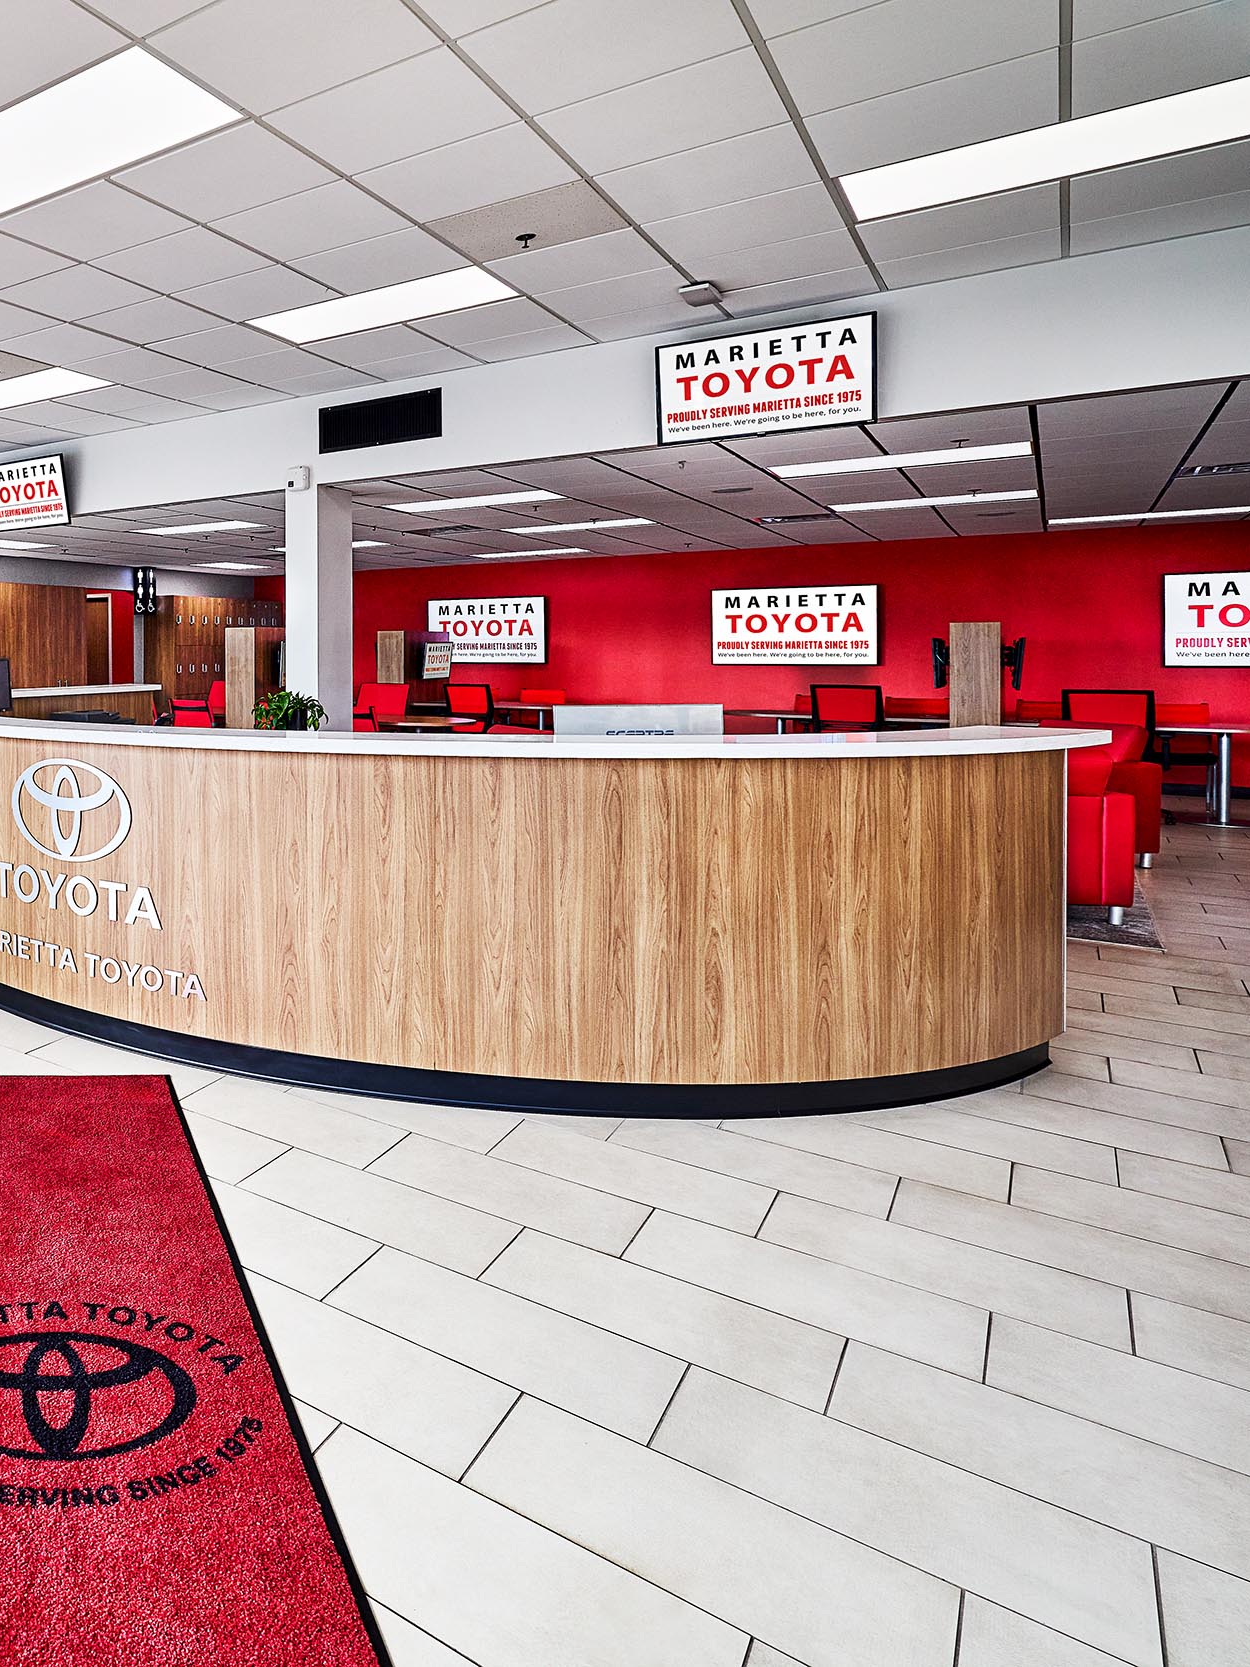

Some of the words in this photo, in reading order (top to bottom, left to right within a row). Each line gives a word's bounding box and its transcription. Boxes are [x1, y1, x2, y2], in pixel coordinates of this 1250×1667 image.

[675, 328, 857, 369] MARIETTA
[676, 354, 855, 401] TOYOTA
[667, 409, 708, 424] PROUDLY
[710, 404, 750, 419] SERVING
[753, 397, 801, 413] MARIETTA
[804, 393, 834, 407] SINCE
[837, 390, 862, 403] 1975
[734, 418, 756, 426] We're
[758, 415, 780, 424] going
[438, 603, 534, 616] MARIETTA
[724, 593, 866, 608] MARIETTA
[439, 619, 534, 636] TOYOTA
[725, 612, 864, 633] TOYOTA
[717, 641, 749, 650] PROUDLY
[751, 641, 783, 650] SERVING
[785, 641, 823, 650] MARIETTA
[824, 641, 848, 650] SINCE
[850, 640, 869, 650] 1975
[1175, 637, 1223, 648] PROUDLY
[84, 951, 207, 1001] TOYOTA
[82, 1301, 245, 1376] TOYOTA
[127, 1456, 218, 1501] SINCE
[215, 1415, 264, 1463] 1975
